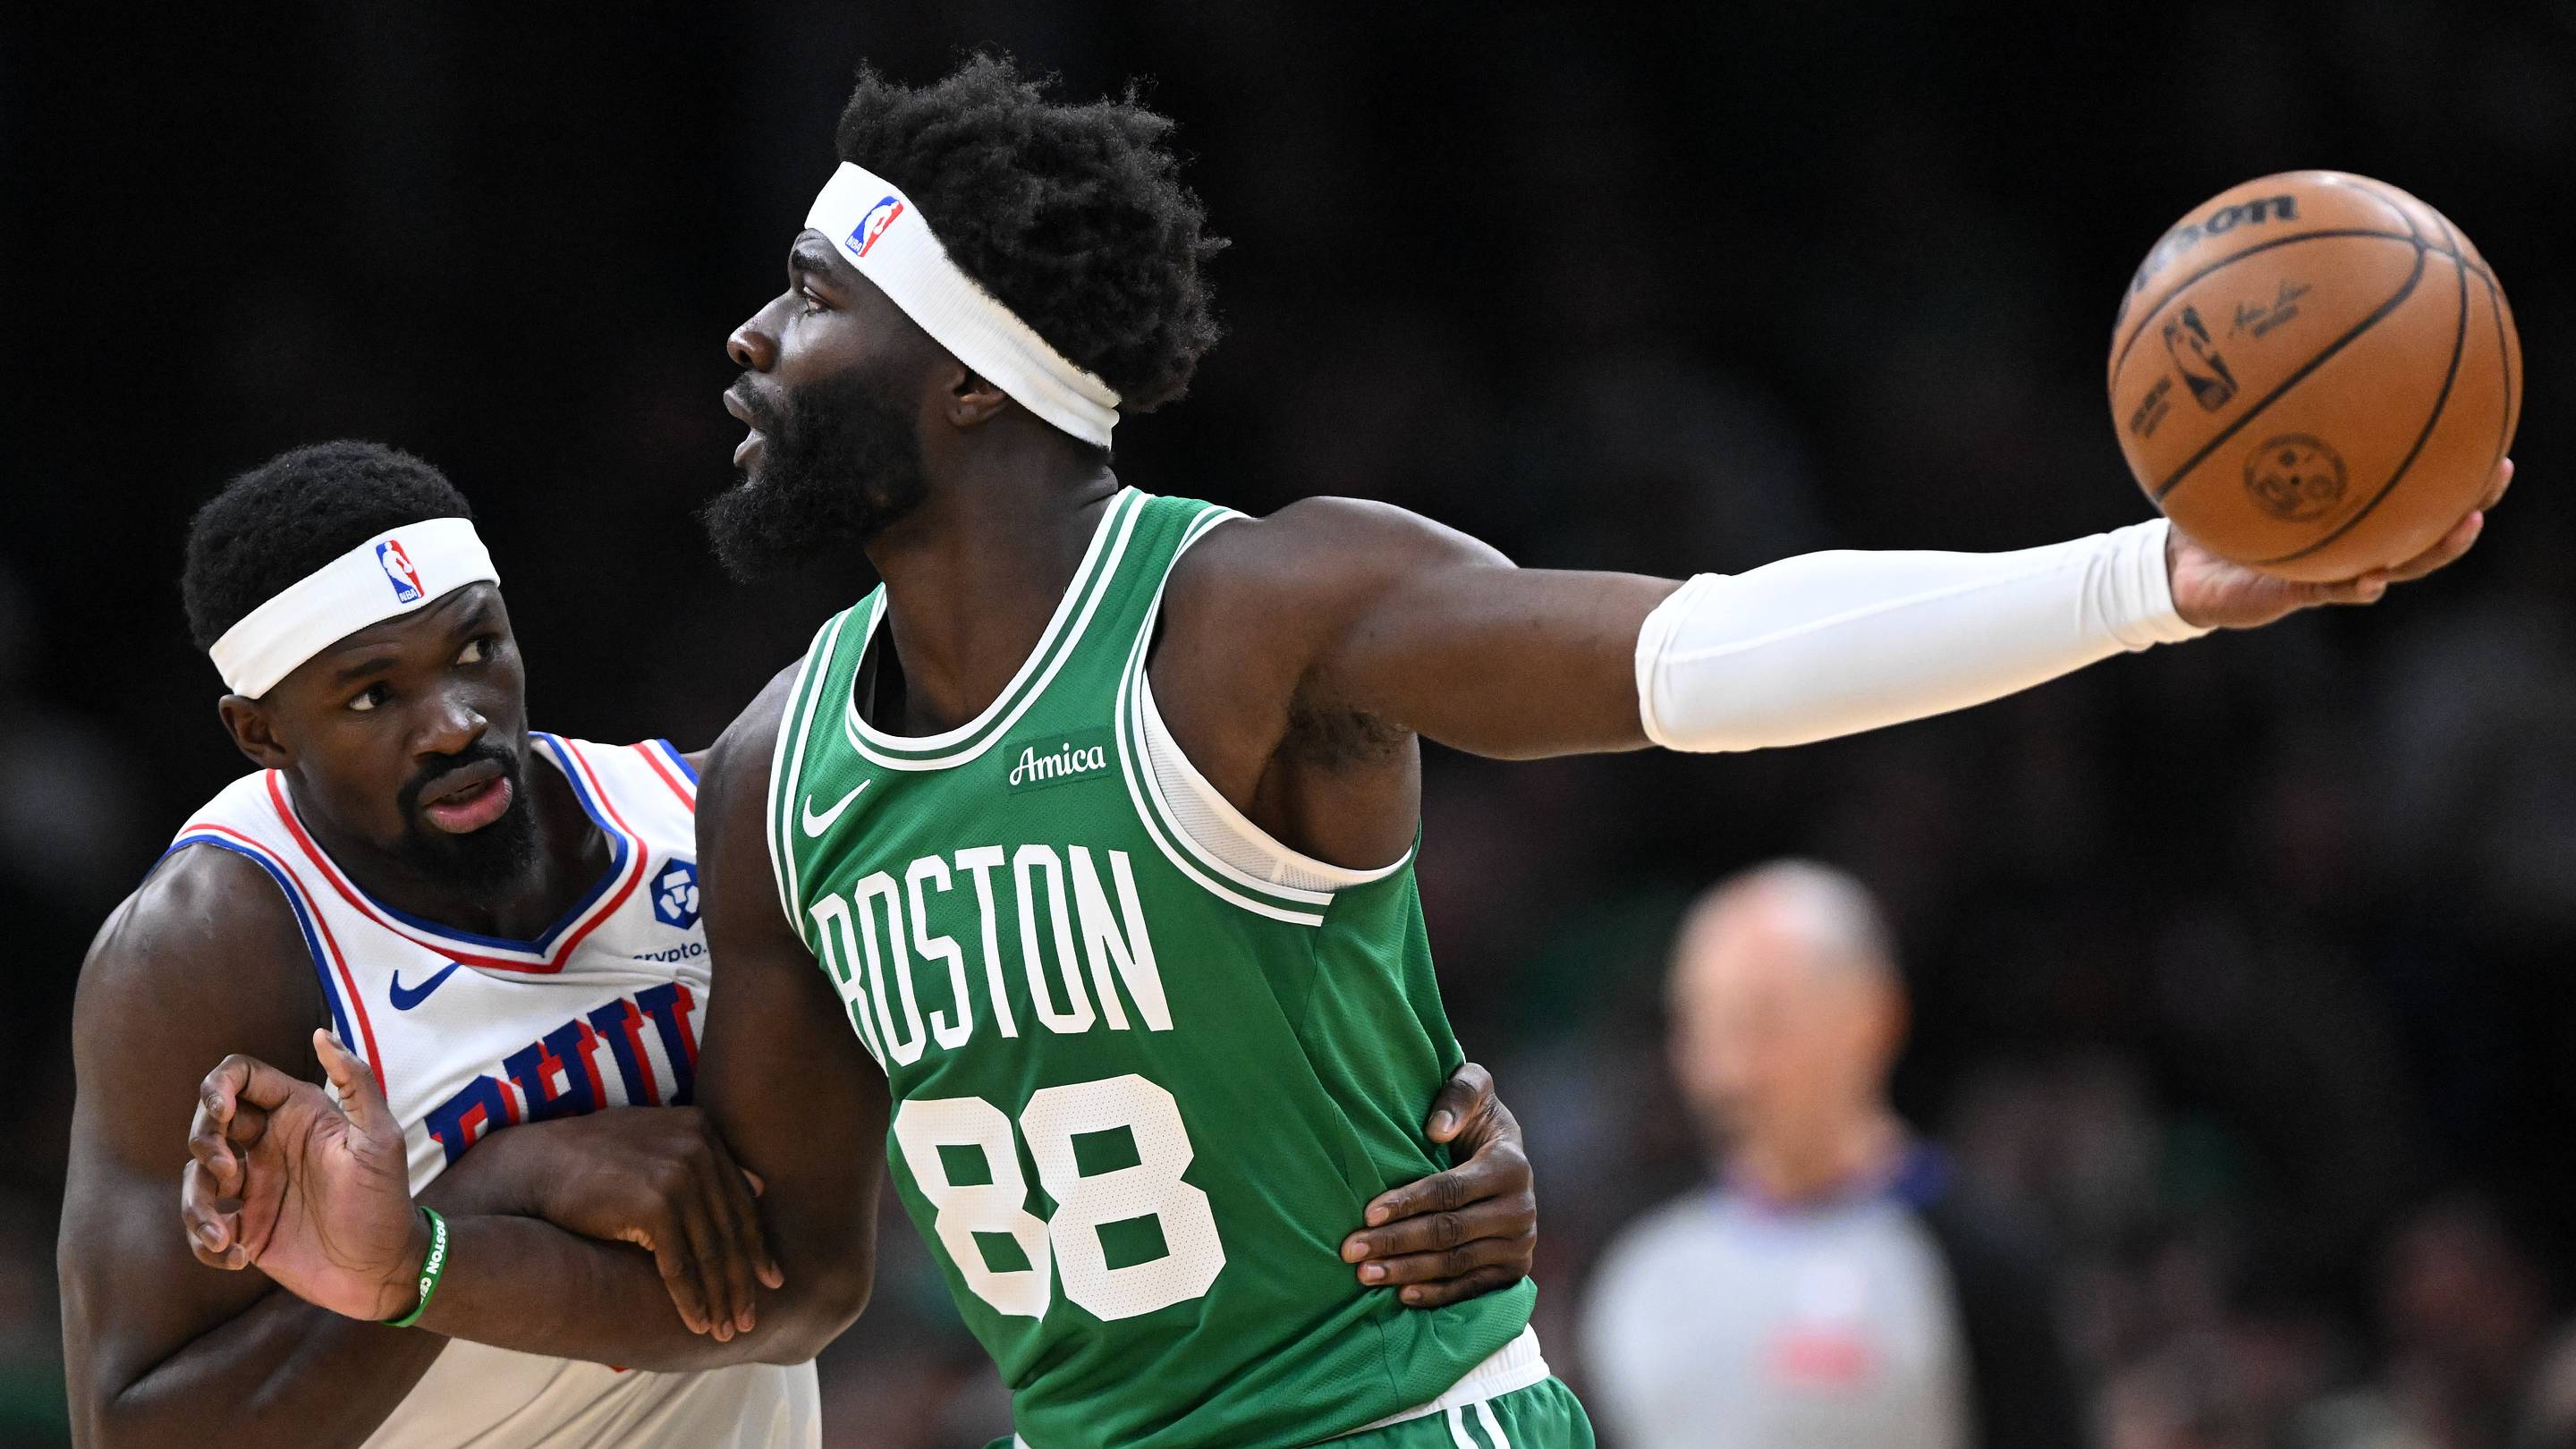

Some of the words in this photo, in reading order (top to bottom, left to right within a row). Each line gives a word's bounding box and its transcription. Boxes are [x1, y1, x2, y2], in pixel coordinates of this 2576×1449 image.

[846, 235, 862, 252] NBA
[399, 589, 417, 601] NBA
[1009, 742, 1106, 786] Amica
[808, 843, 1174, 1077] BOSTON
[894, 1073, 1226, 1324] 88
[425, 1218, 447, 1275] BOSTON
